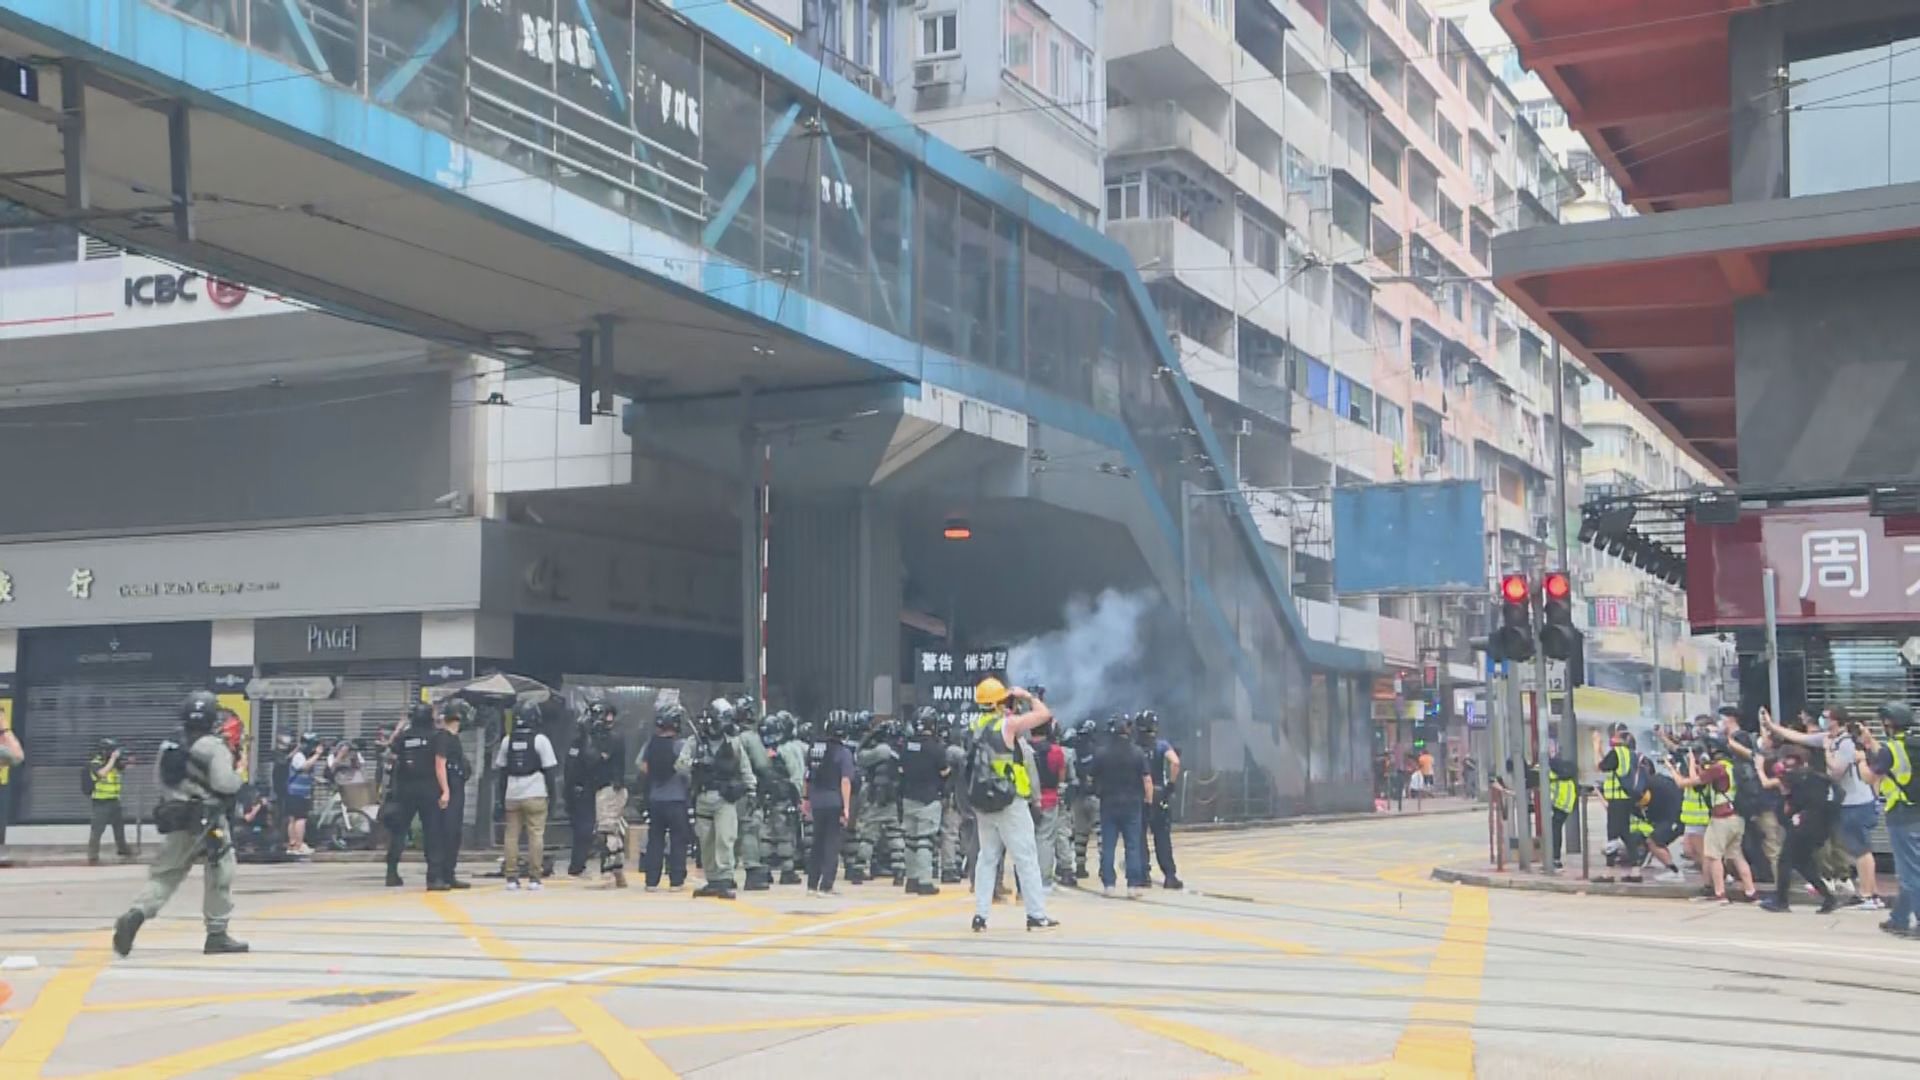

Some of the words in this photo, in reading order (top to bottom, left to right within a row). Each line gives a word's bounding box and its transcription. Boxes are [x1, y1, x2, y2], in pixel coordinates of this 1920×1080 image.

[125, 273, 197, 306] ICBC
[1799, 528, 1920, 598] 周
[921, 651, 953, 672] 警告
